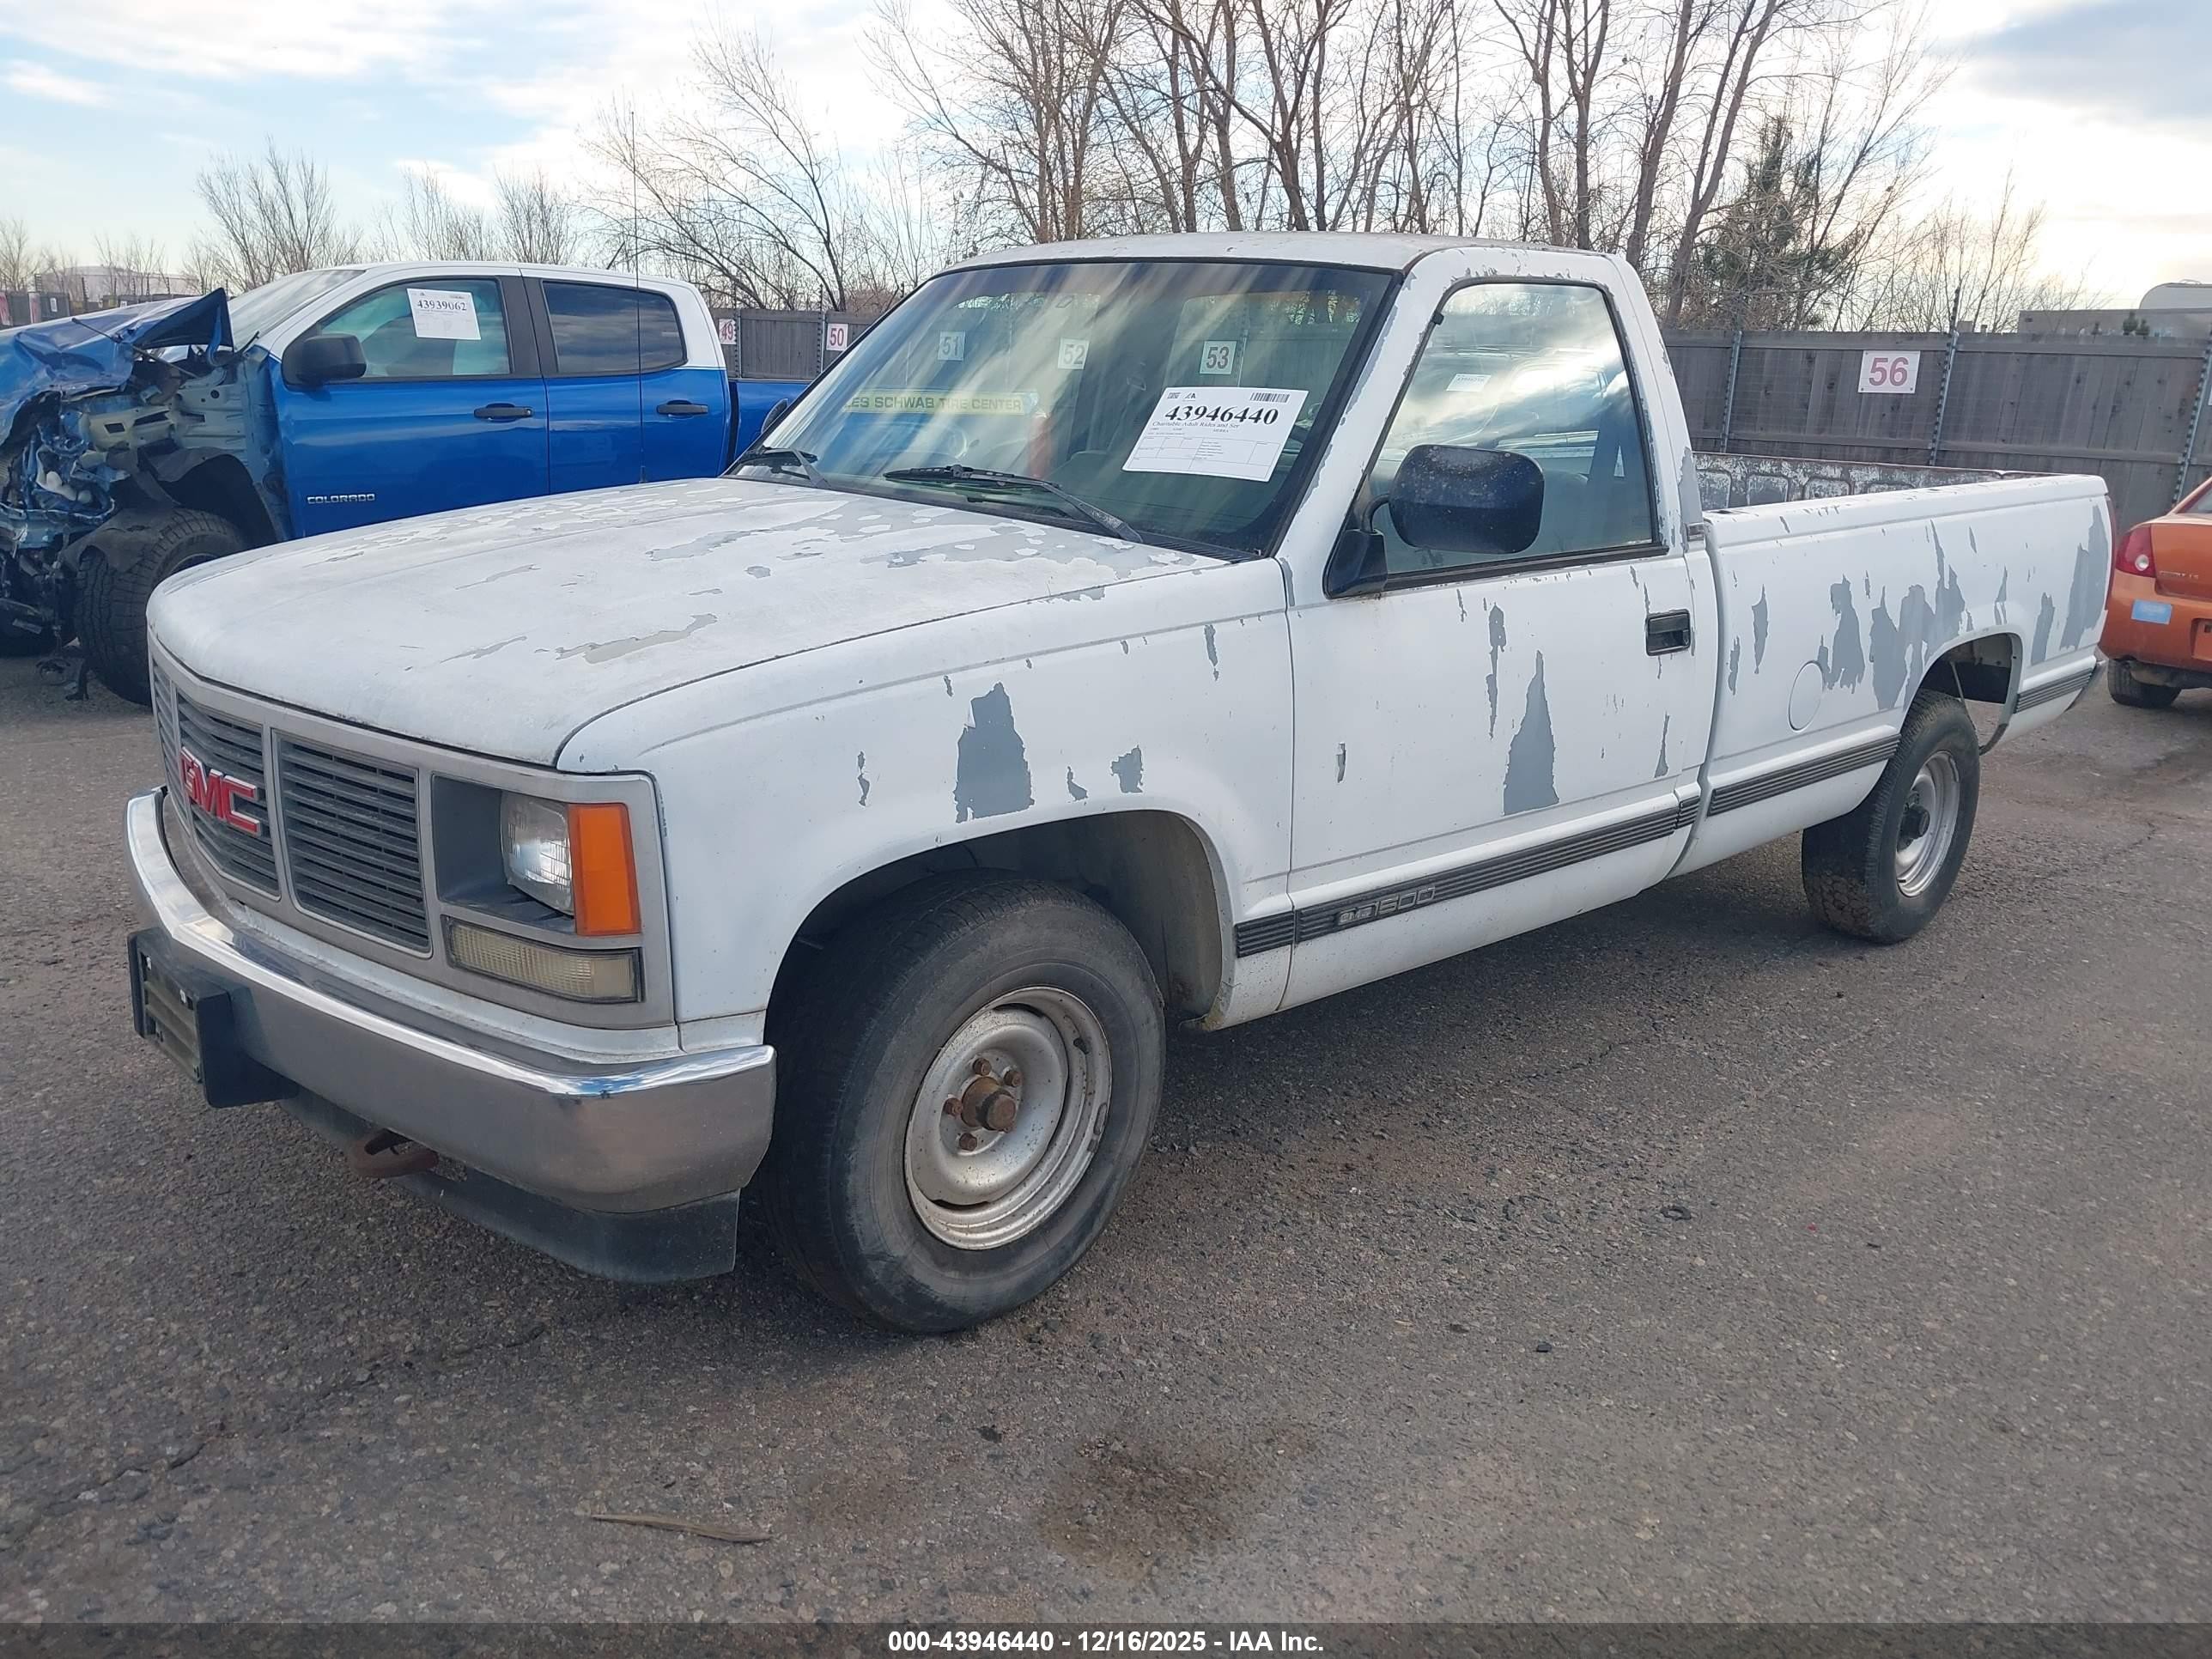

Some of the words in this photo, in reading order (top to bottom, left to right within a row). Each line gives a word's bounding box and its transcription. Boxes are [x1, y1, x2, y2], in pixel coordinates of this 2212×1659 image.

[417, 299, 467, 311] 43939062
[721, 323, 734, 341] 49
[830, 328, 845, 347] 50
[943, 336, 959, 356] 51
[1064, 344, 1085, 365] 52
[1206, 346, 1230, 369] 53
[1869, 356, 1909, 386] 56
[846, 397, 870, 408] ES
[874, 397, 935, 409] SCHWAB
[939, 398, 969, 410] TIRE
[971, 398, 1022, 411] CENTER
[1165, 405, 1279, 425] 43946440
[307, 494, 375, 504] COLORADO
[179, 746, 261, 837] GMC
